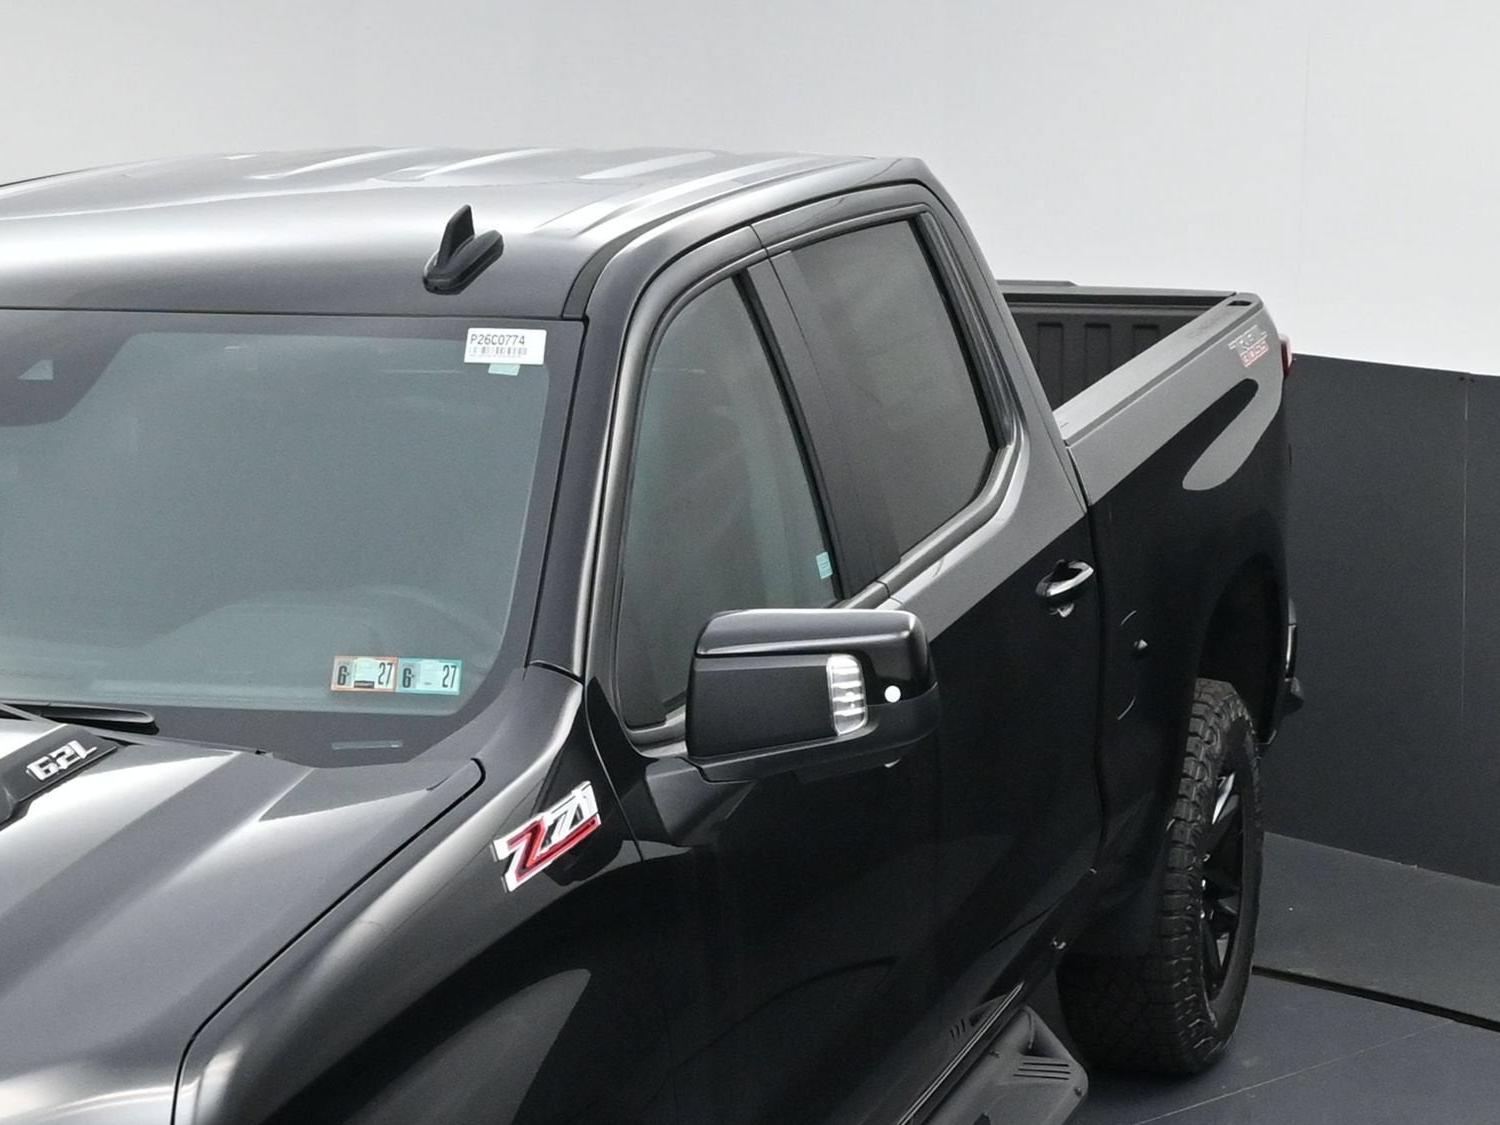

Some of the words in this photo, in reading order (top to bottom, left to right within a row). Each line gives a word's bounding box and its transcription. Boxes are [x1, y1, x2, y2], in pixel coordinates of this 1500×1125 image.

[470, 333, 525, 346] P26C0774
[337, 665, 347, 686] 6
[378, 662, 393, 687] 27
[402, 668, 412, 688] 6
[442, 665, 457, 688] 27
[491, 780, 602, 892] Z71
